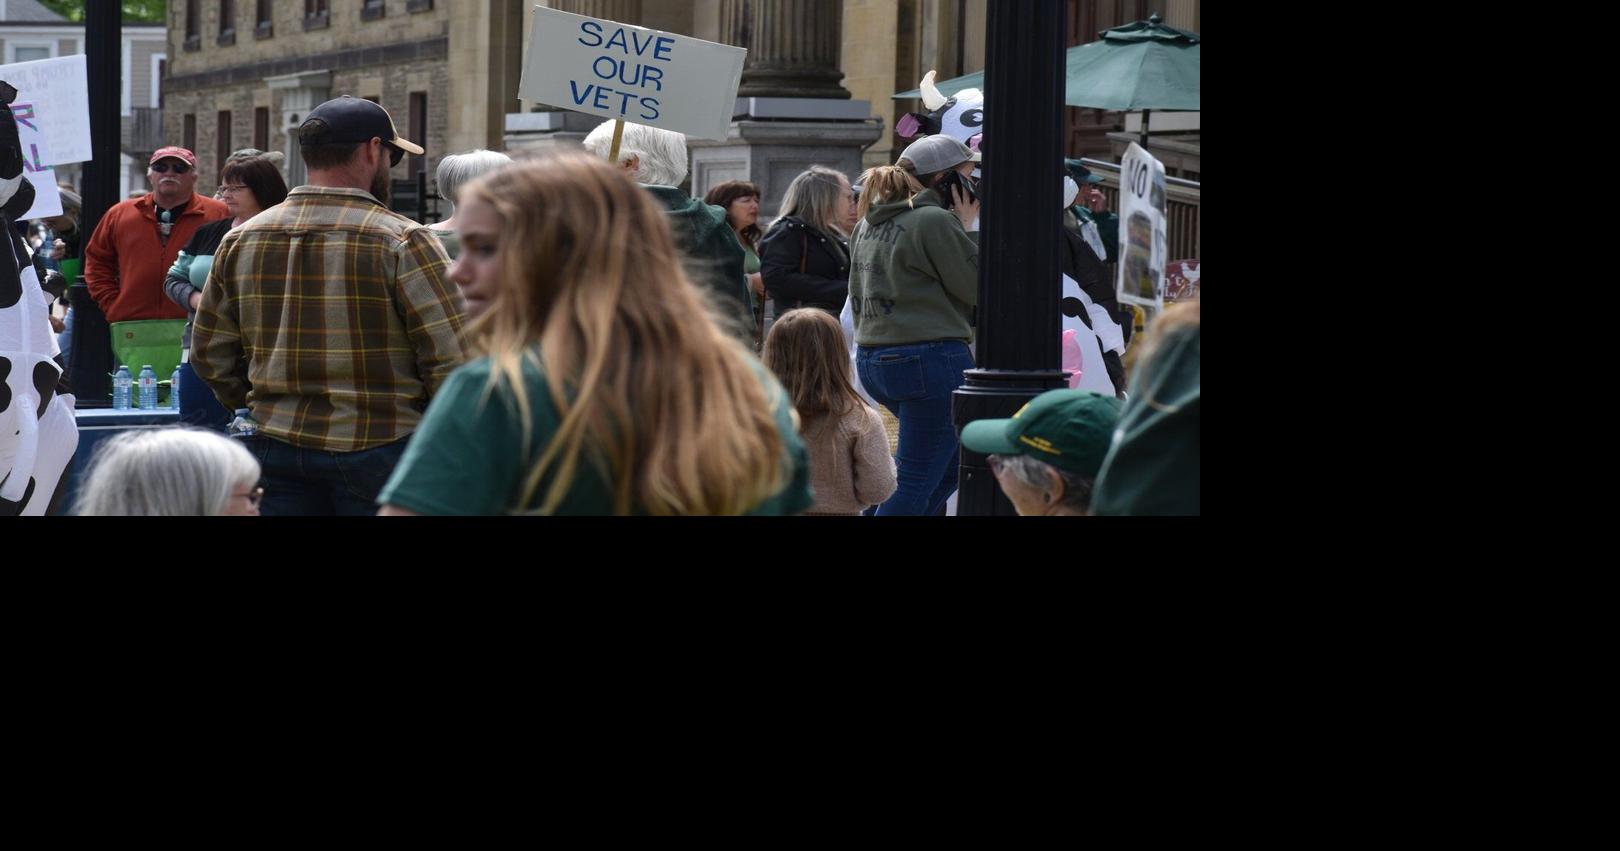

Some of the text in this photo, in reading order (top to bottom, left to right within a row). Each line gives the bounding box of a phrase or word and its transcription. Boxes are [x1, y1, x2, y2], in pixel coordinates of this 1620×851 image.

[578, 21, 675, 61] SAVE
[593, 55, 663, 91] OUR
[570, 80, 660, 120] VETS
[1128, 158, 1148, 198] NO
